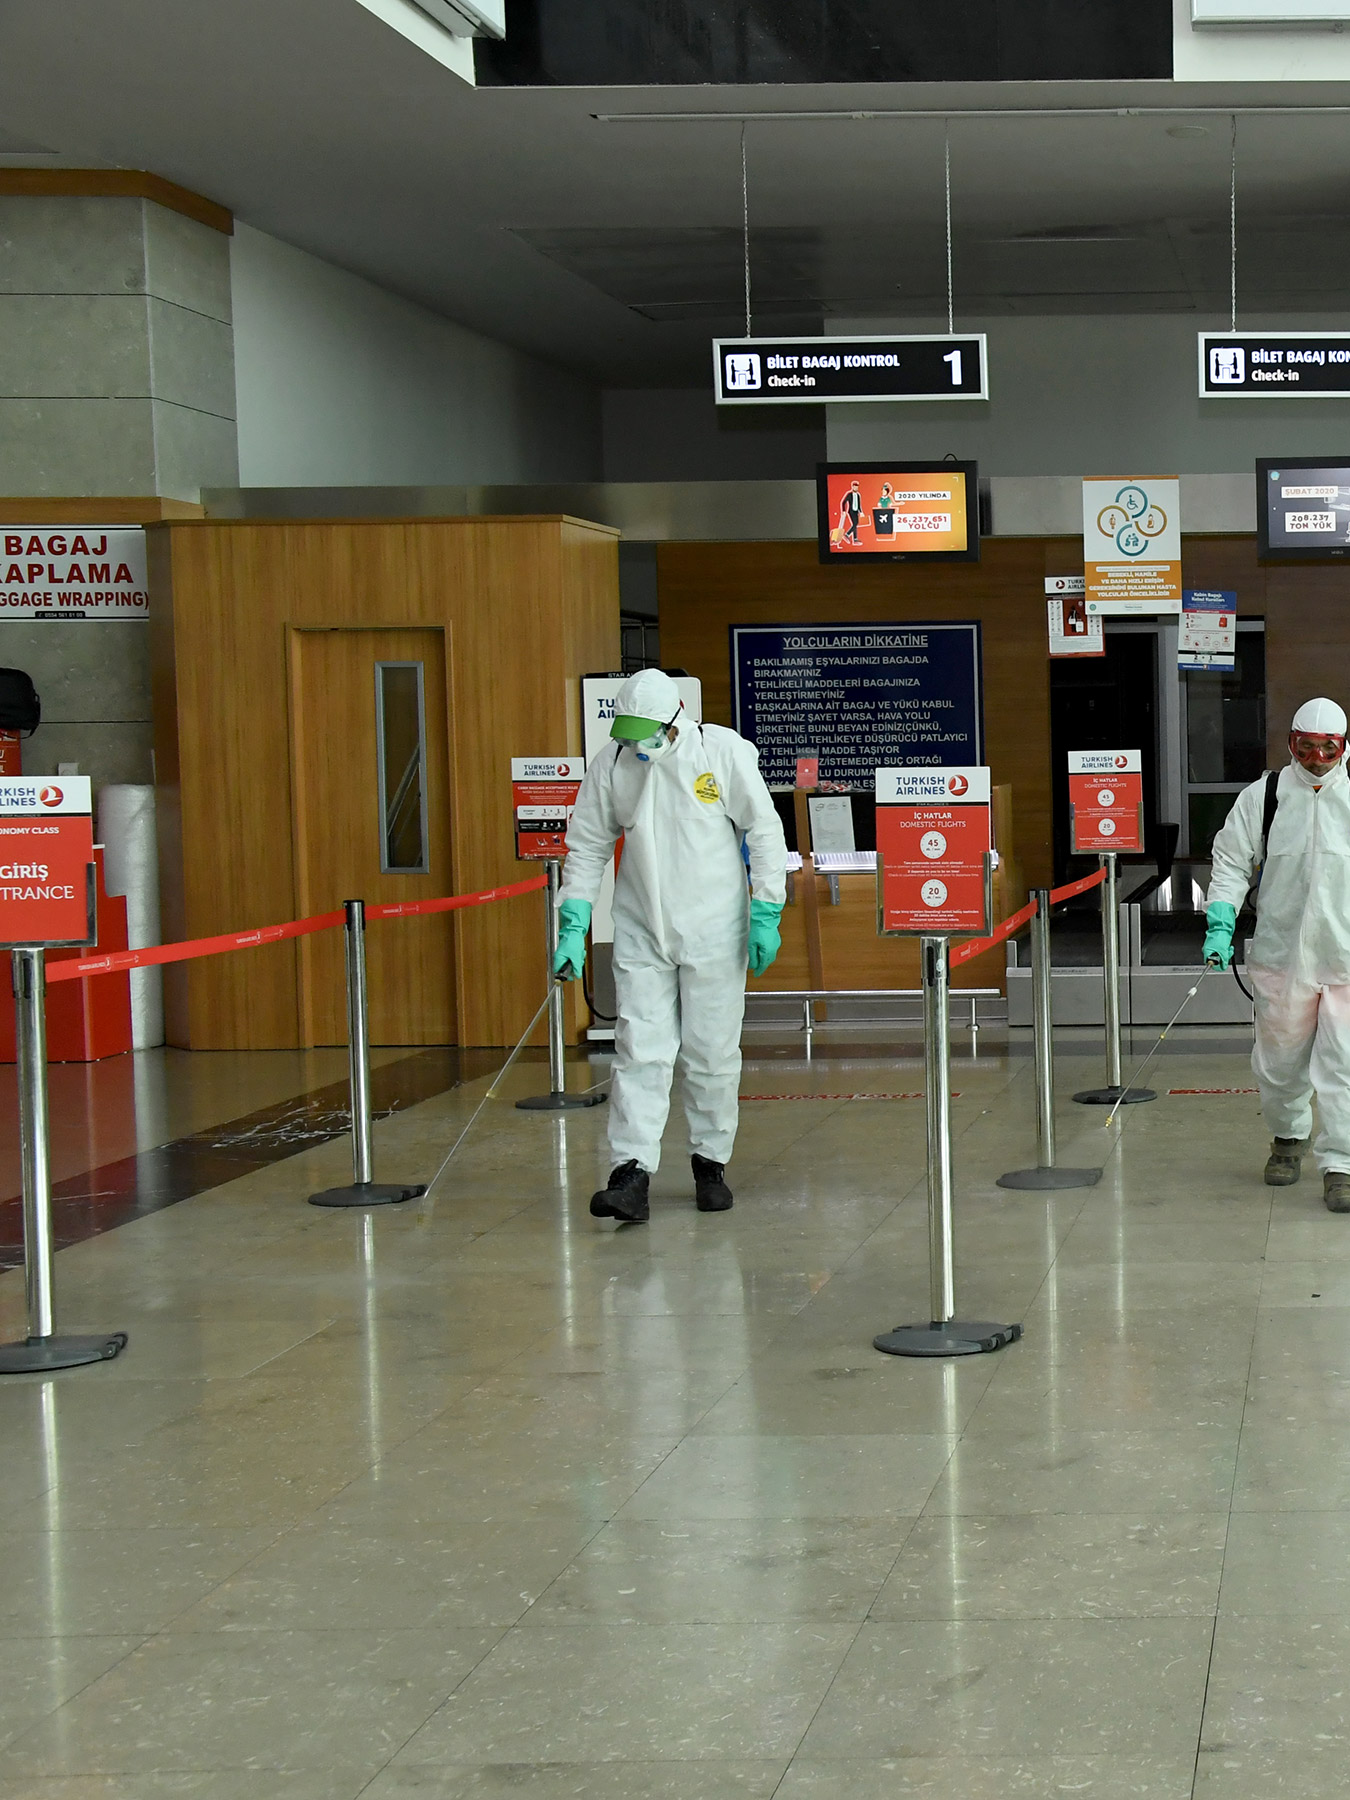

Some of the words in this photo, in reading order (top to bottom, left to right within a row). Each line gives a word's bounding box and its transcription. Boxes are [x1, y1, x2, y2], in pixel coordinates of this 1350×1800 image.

[767, 354, 799, 369] BİLET
[802, 356, 841, 370] BAGAJ
[844, 354, 900, 367] KONTROL
[1252, 349, 1283, 363] BİLET
[1287, 351, 1325, 365] BAGAJ
[943, 350, 962, 385] 1
[768, 375, 816, 386] Check-in
[1252, 369, 1299, 381] Check-in
[909, 522, 940, 530] YOLCU
[5, 535, 107, 556] BAGAJ
[0, 563, 134, 583] APLAMA
[58, 592, 149, 610] WRAPPING)
[783, 636, 862, 649] YOLCULARIN
[864, 633, 928, 647] DİKKATİNE
[754, 658, 814, 667] BAKILMAMIŞ
[816, 656, 880, 666] EŞYALARINIZI
[882, 656, 929, 664] BAGAJDA
[754, 669, 822, 677] BIRAKMAYINIZ
[754, 679, 803, 689] TEHLİKELİ
[805, 678, 861, 688] MADDELERİ
[863, 678, 920, 687] BAGAJINIZA
[755, 689, 845, 701] YERLEŞTİRMEYİNİZ
[755, 702, 823, 712] BAŞKALARINA
[825, 700, 840, 710] AİT
[843, 701, 876, 710] BAGAJ
[878, 701, 890, 709] VE
[893, 699, 919, 708] YÜKÜ
[921, 700, 955, 708] KABUL
[755, 712, 806, 722] ETMEYİNİZ
[807, 713, 837, 723] ŞAYET
[840, 712, 875, 721] VARSA,
[905, 711, 931, 719] YOLU
[755, 723, 806, 734] ŞİRKETİNE
[808, 723, 835, 732] BUNU
[837, 723, 869, 731] BEYAN
[756, 734, 808, 745] GÜVENLİĞİ
[810, 733, 862, 743] TEHLİKEYE
[865, 732, 918, 744] DÜŞÜRÜCÜ
[920, 734, 968, 742] PATLAYICI
[822, 746, 857, 754] MADDE
[858, 745, 899, 756] TAŞIYOR
[896, 776, 945, 786] TURKISH
[896, 786, 945, 795] AIRLINES
[914, 811, 921, 820] İÇ
[0, 862, 48, 881] GİRİŞ
